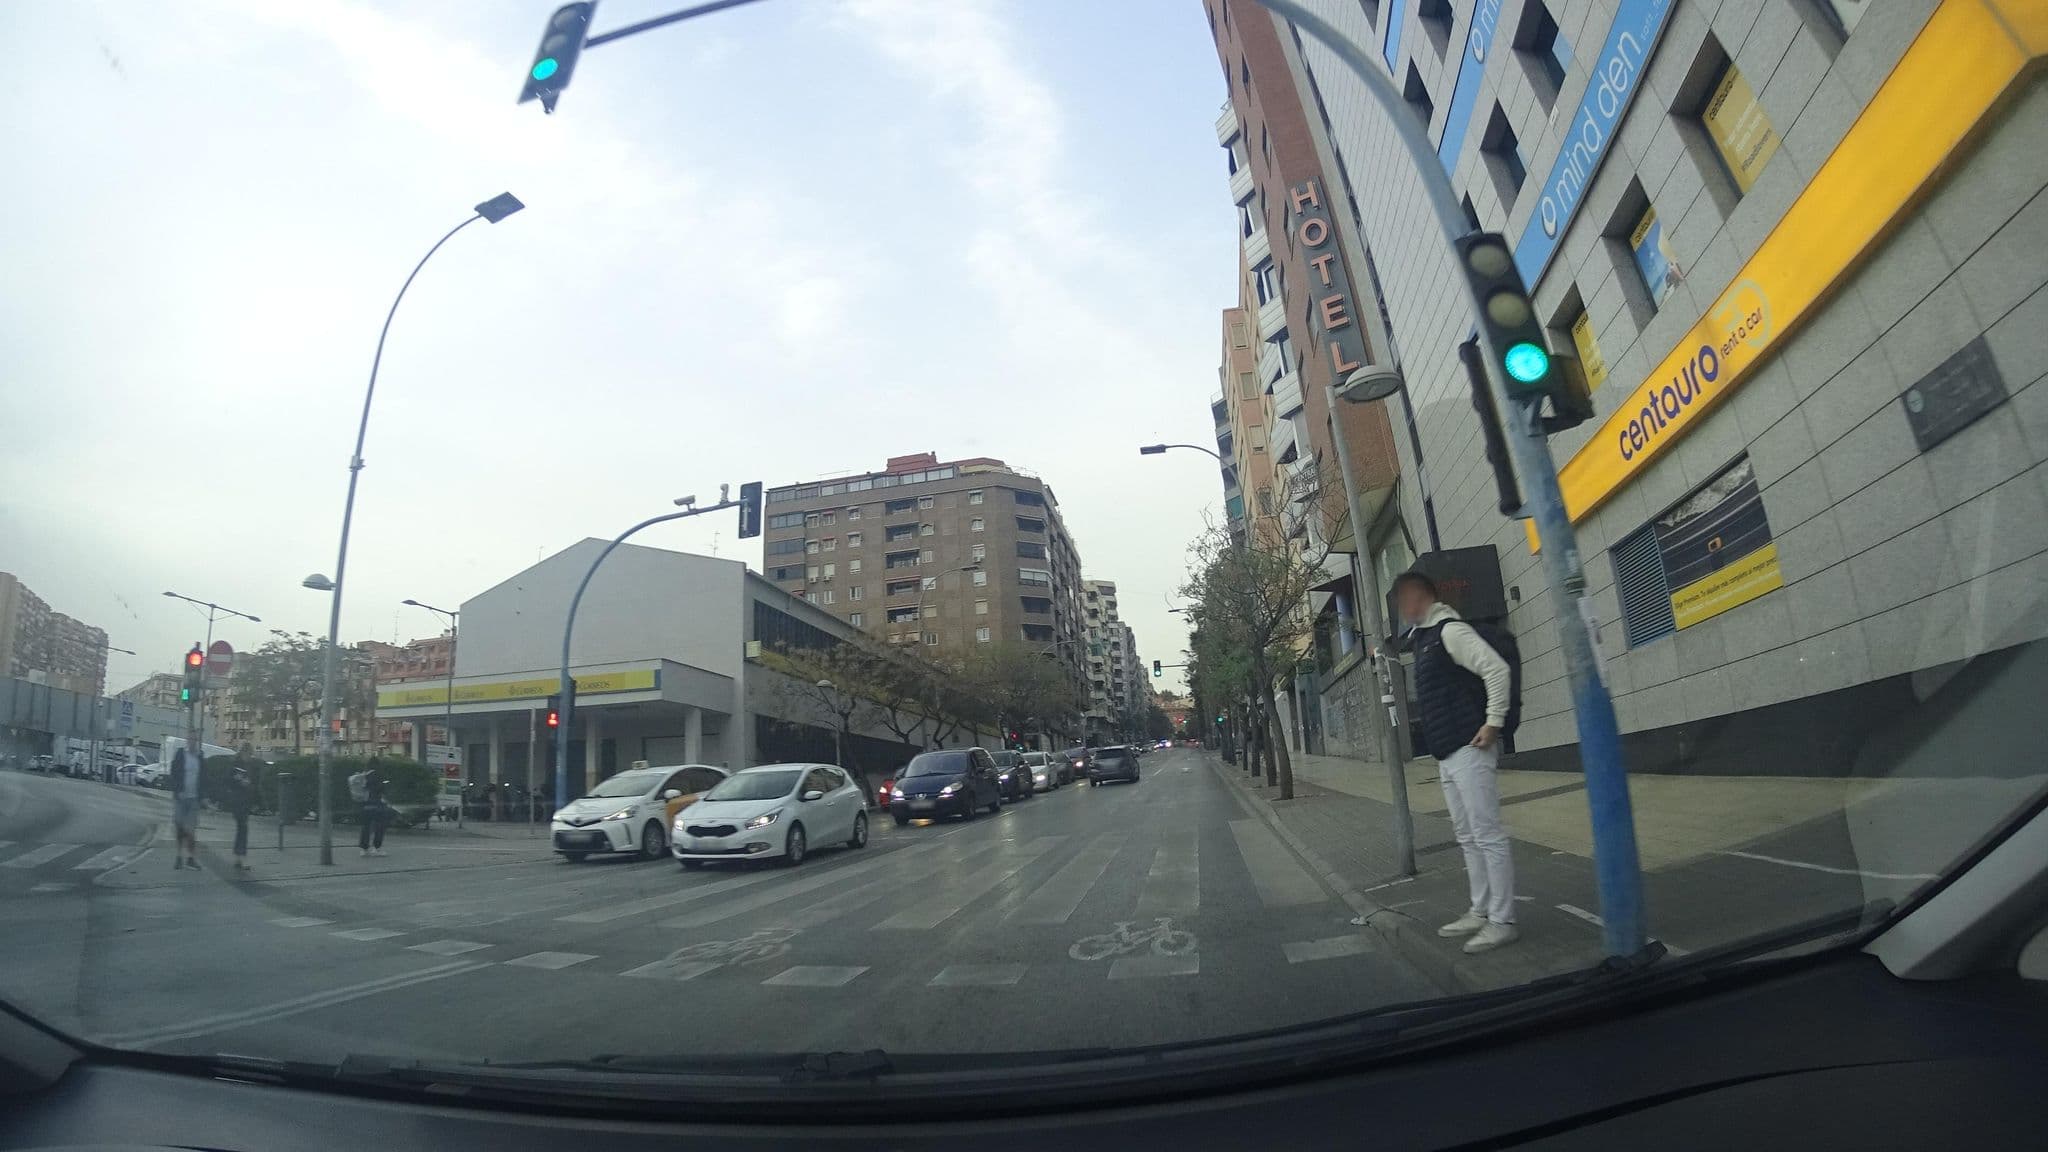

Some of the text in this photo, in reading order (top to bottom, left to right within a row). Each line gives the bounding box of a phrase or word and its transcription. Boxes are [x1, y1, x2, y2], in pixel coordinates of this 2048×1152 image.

[1556, 106, 1603, 213] mind
[1597, 31, 1641, 119] den
[1290, 180, 1361, 377] HOTEL
[1619, 345, 1719, 461] centauro
[1719, 331, 1739, 360] rent
[1738, 326, 1747, 339] a
[1746, 307, 1763, 330] car
